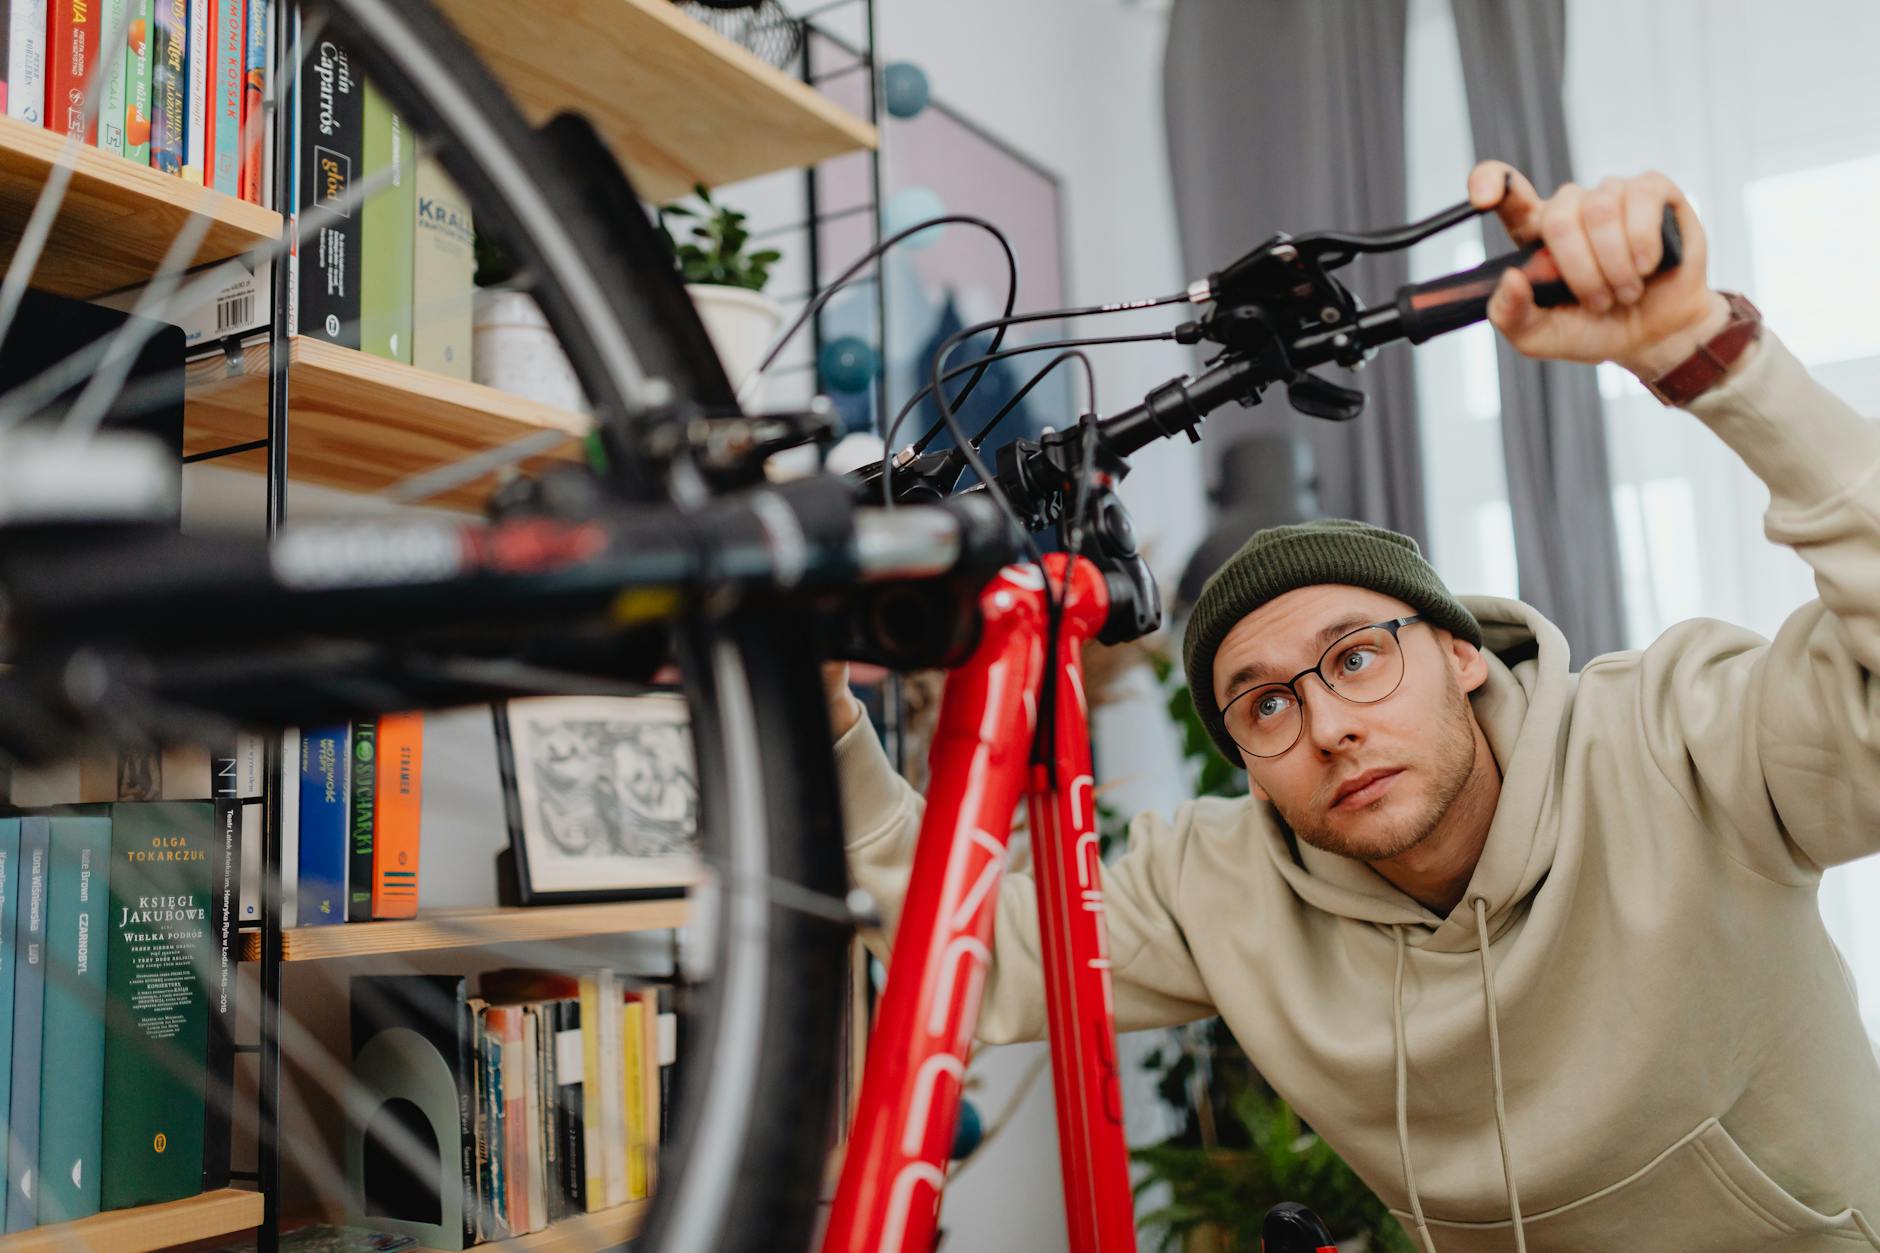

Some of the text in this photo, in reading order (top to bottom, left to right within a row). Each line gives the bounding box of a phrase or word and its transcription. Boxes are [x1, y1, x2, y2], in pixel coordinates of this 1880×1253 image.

[77, 53, 85, 77] DOBRA
[337, 48, 355, 94] artín
[135, 41, 147, 124] Petra Hůlová
[227, 57, 238, 119] KOSSAK
[313, 41, 341, 136] Caparrós
[226, 809, 234, 830] Teatr
[152, 837, 187, 848] OLGA
[225, 829, 233, 850] Lalek
[128, 850, 205, 863] TOKARCZUK
[80, 871, 91, 902] Brown
[30, 875, 42, 932] Wiśniewska
[139, 896, 194, 910] KSIĘGI
[222, 889, 231, 922] Henryka
[119, 907, 206, 928] JAKUBOWE
[77, 913, 89, 976] CZARNOBYL
[124, 928, 203, 944] WIELKA PODRÓŻ
[221, 946, 229, 968] Łodzi
